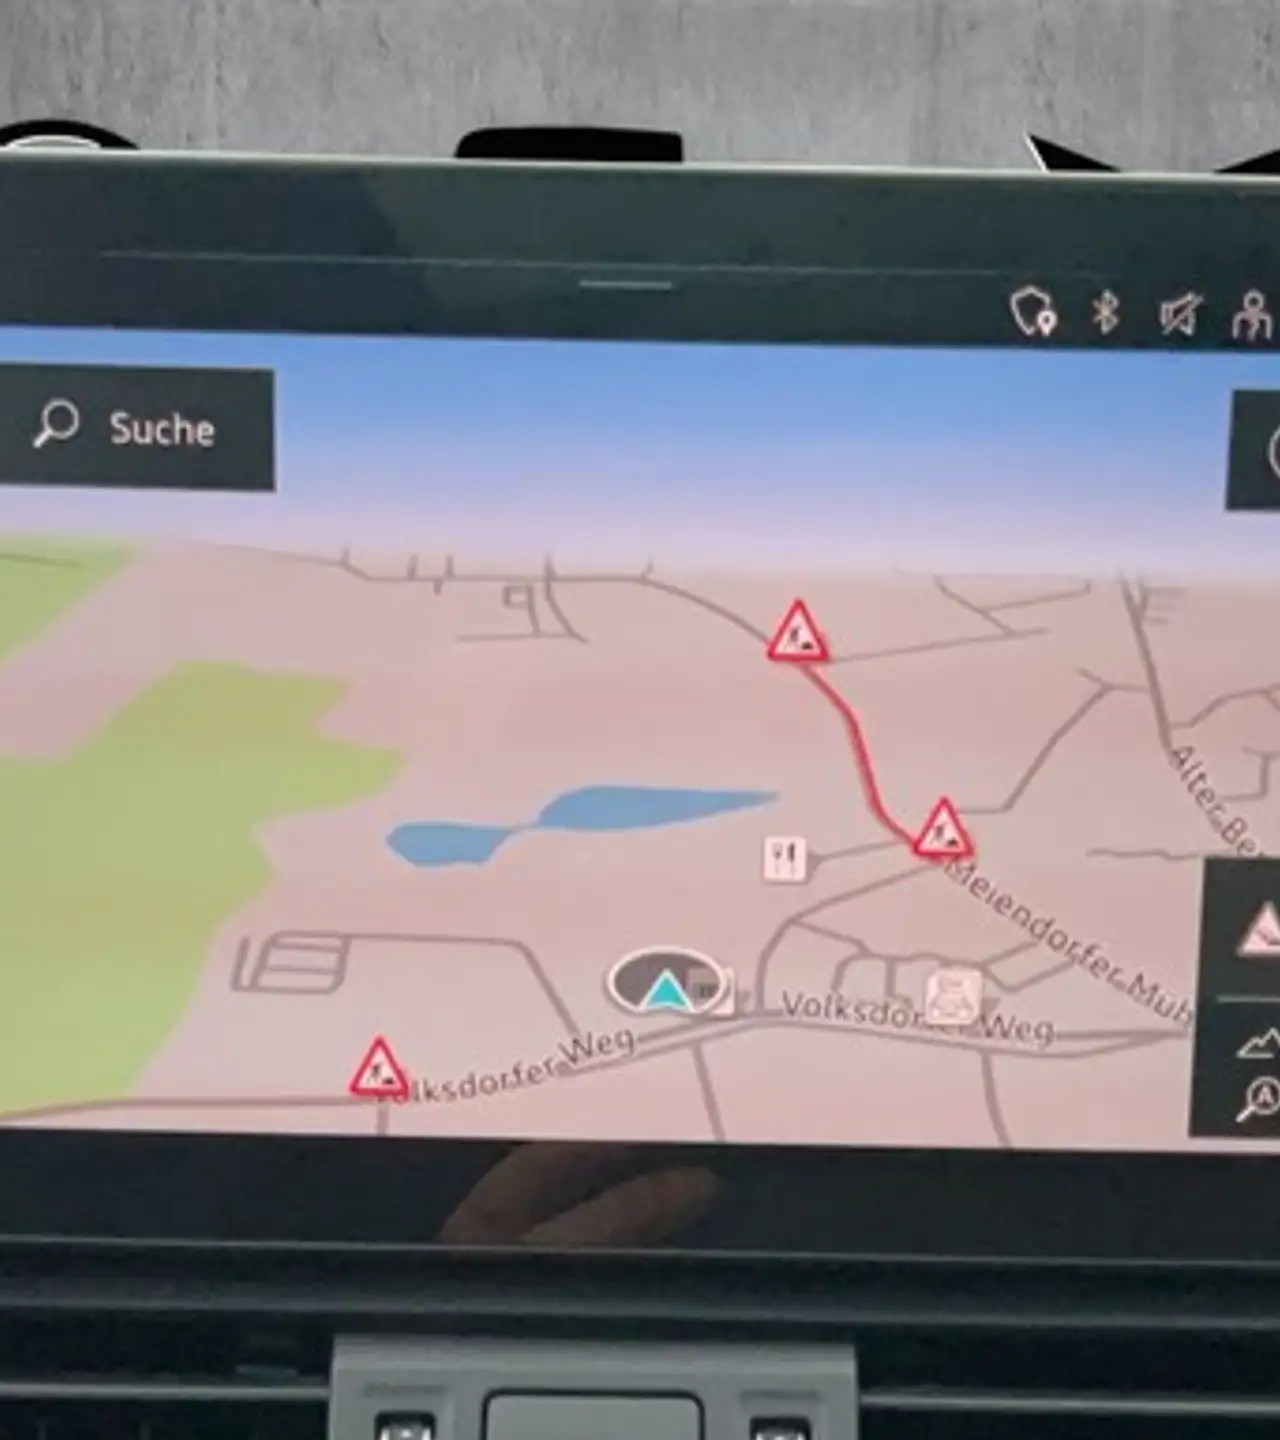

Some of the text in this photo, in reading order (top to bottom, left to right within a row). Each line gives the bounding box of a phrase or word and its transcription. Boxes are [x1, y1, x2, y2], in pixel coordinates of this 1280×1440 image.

[109, 409, 216, 449] Suche
[1170, 744, 1265, 857] Alter Be
[942, 858, 1126, 989] Meiendorfer
[781, 989, 1056, 1051] Volksdor Weg
[377, 1027, 635, 1106] lksdorfer Weg
